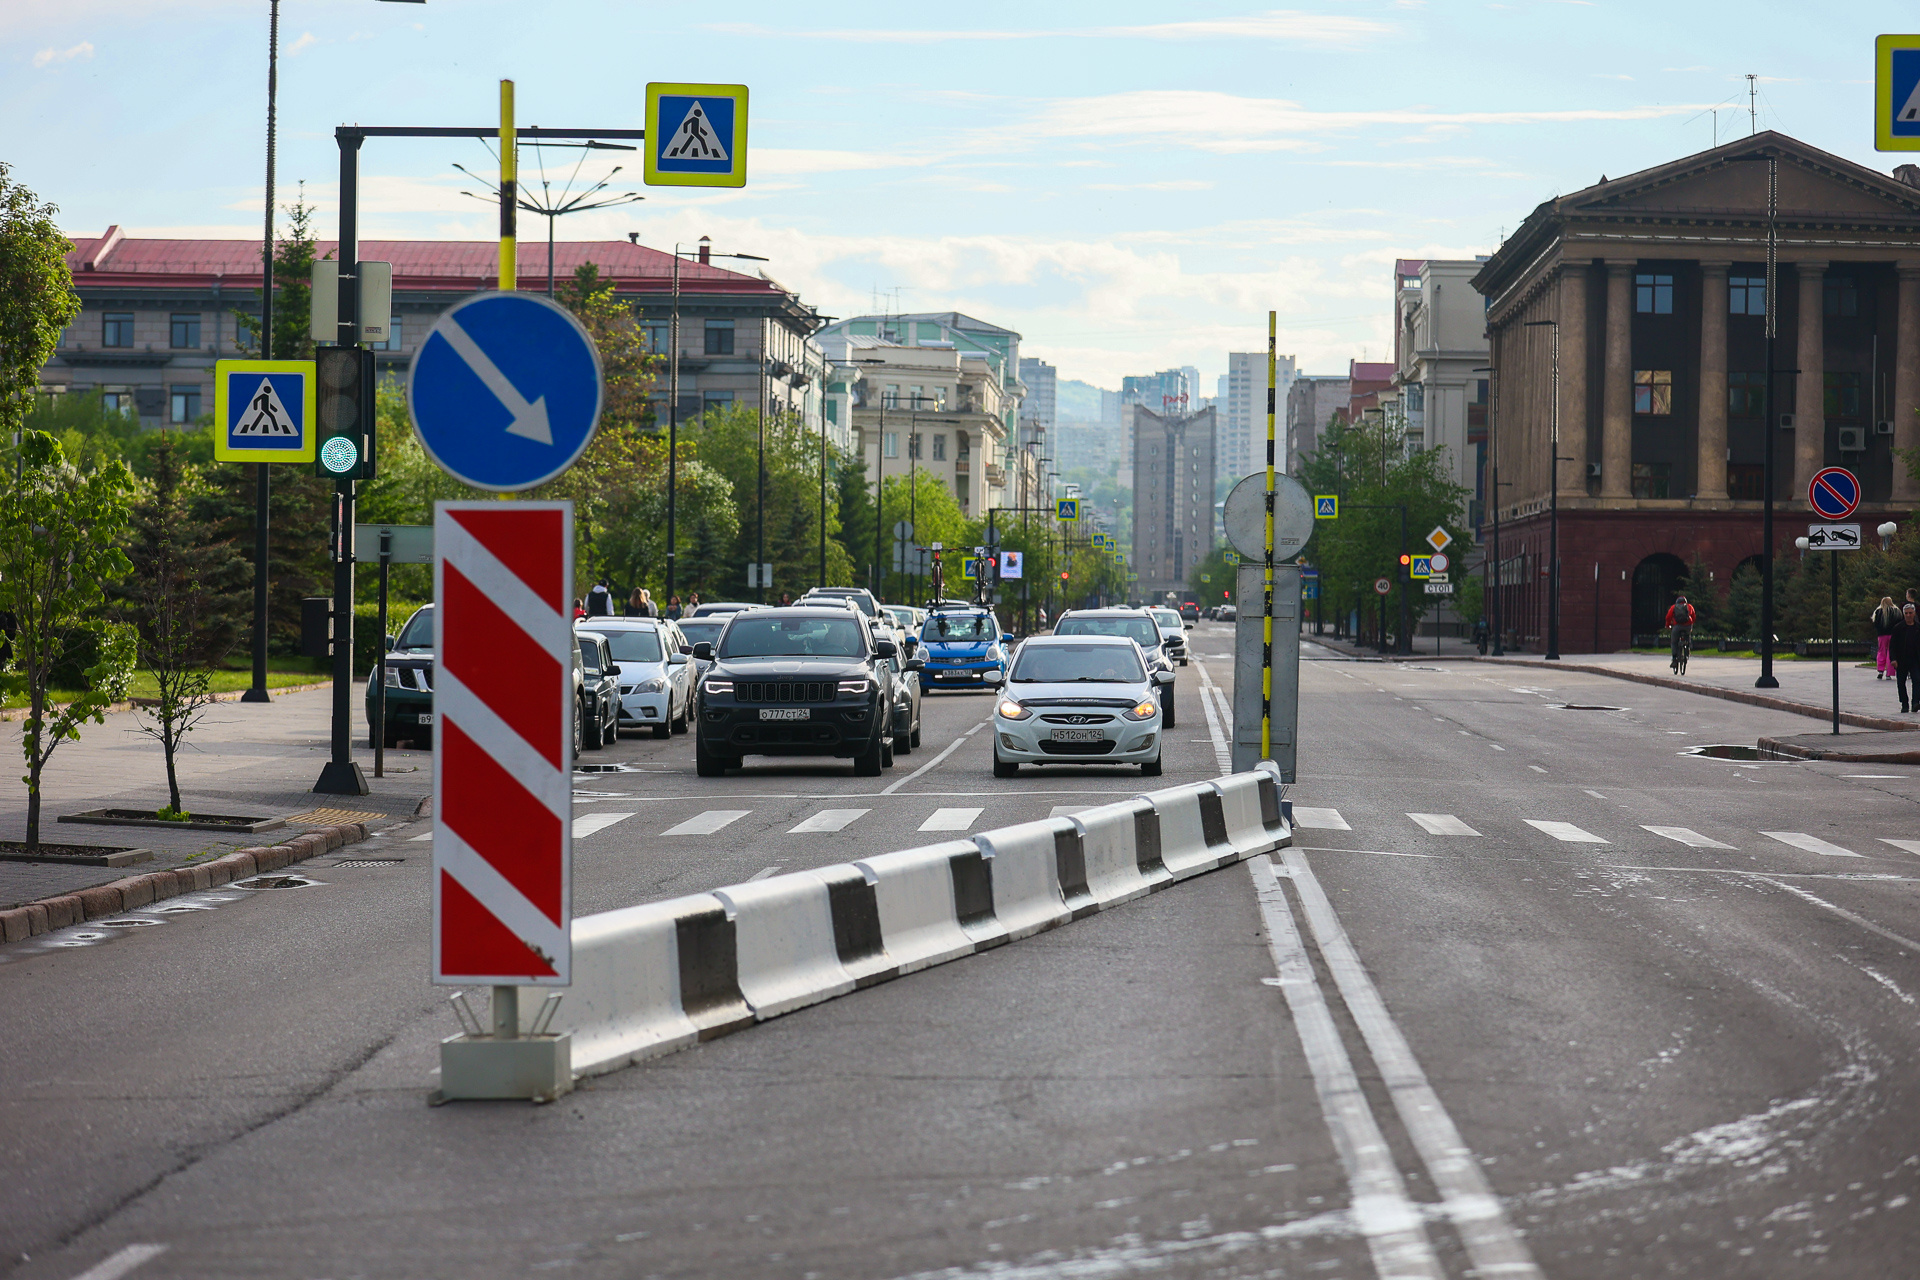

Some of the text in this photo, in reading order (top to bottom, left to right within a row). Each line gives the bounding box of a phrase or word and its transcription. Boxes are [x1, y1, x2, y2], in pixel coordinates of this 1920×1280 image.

[1378, 582, 1388, 590] 40
[1428, 584, 1450, 592] СТОП
[1053, 730, 1087, 740] Н512ОН
